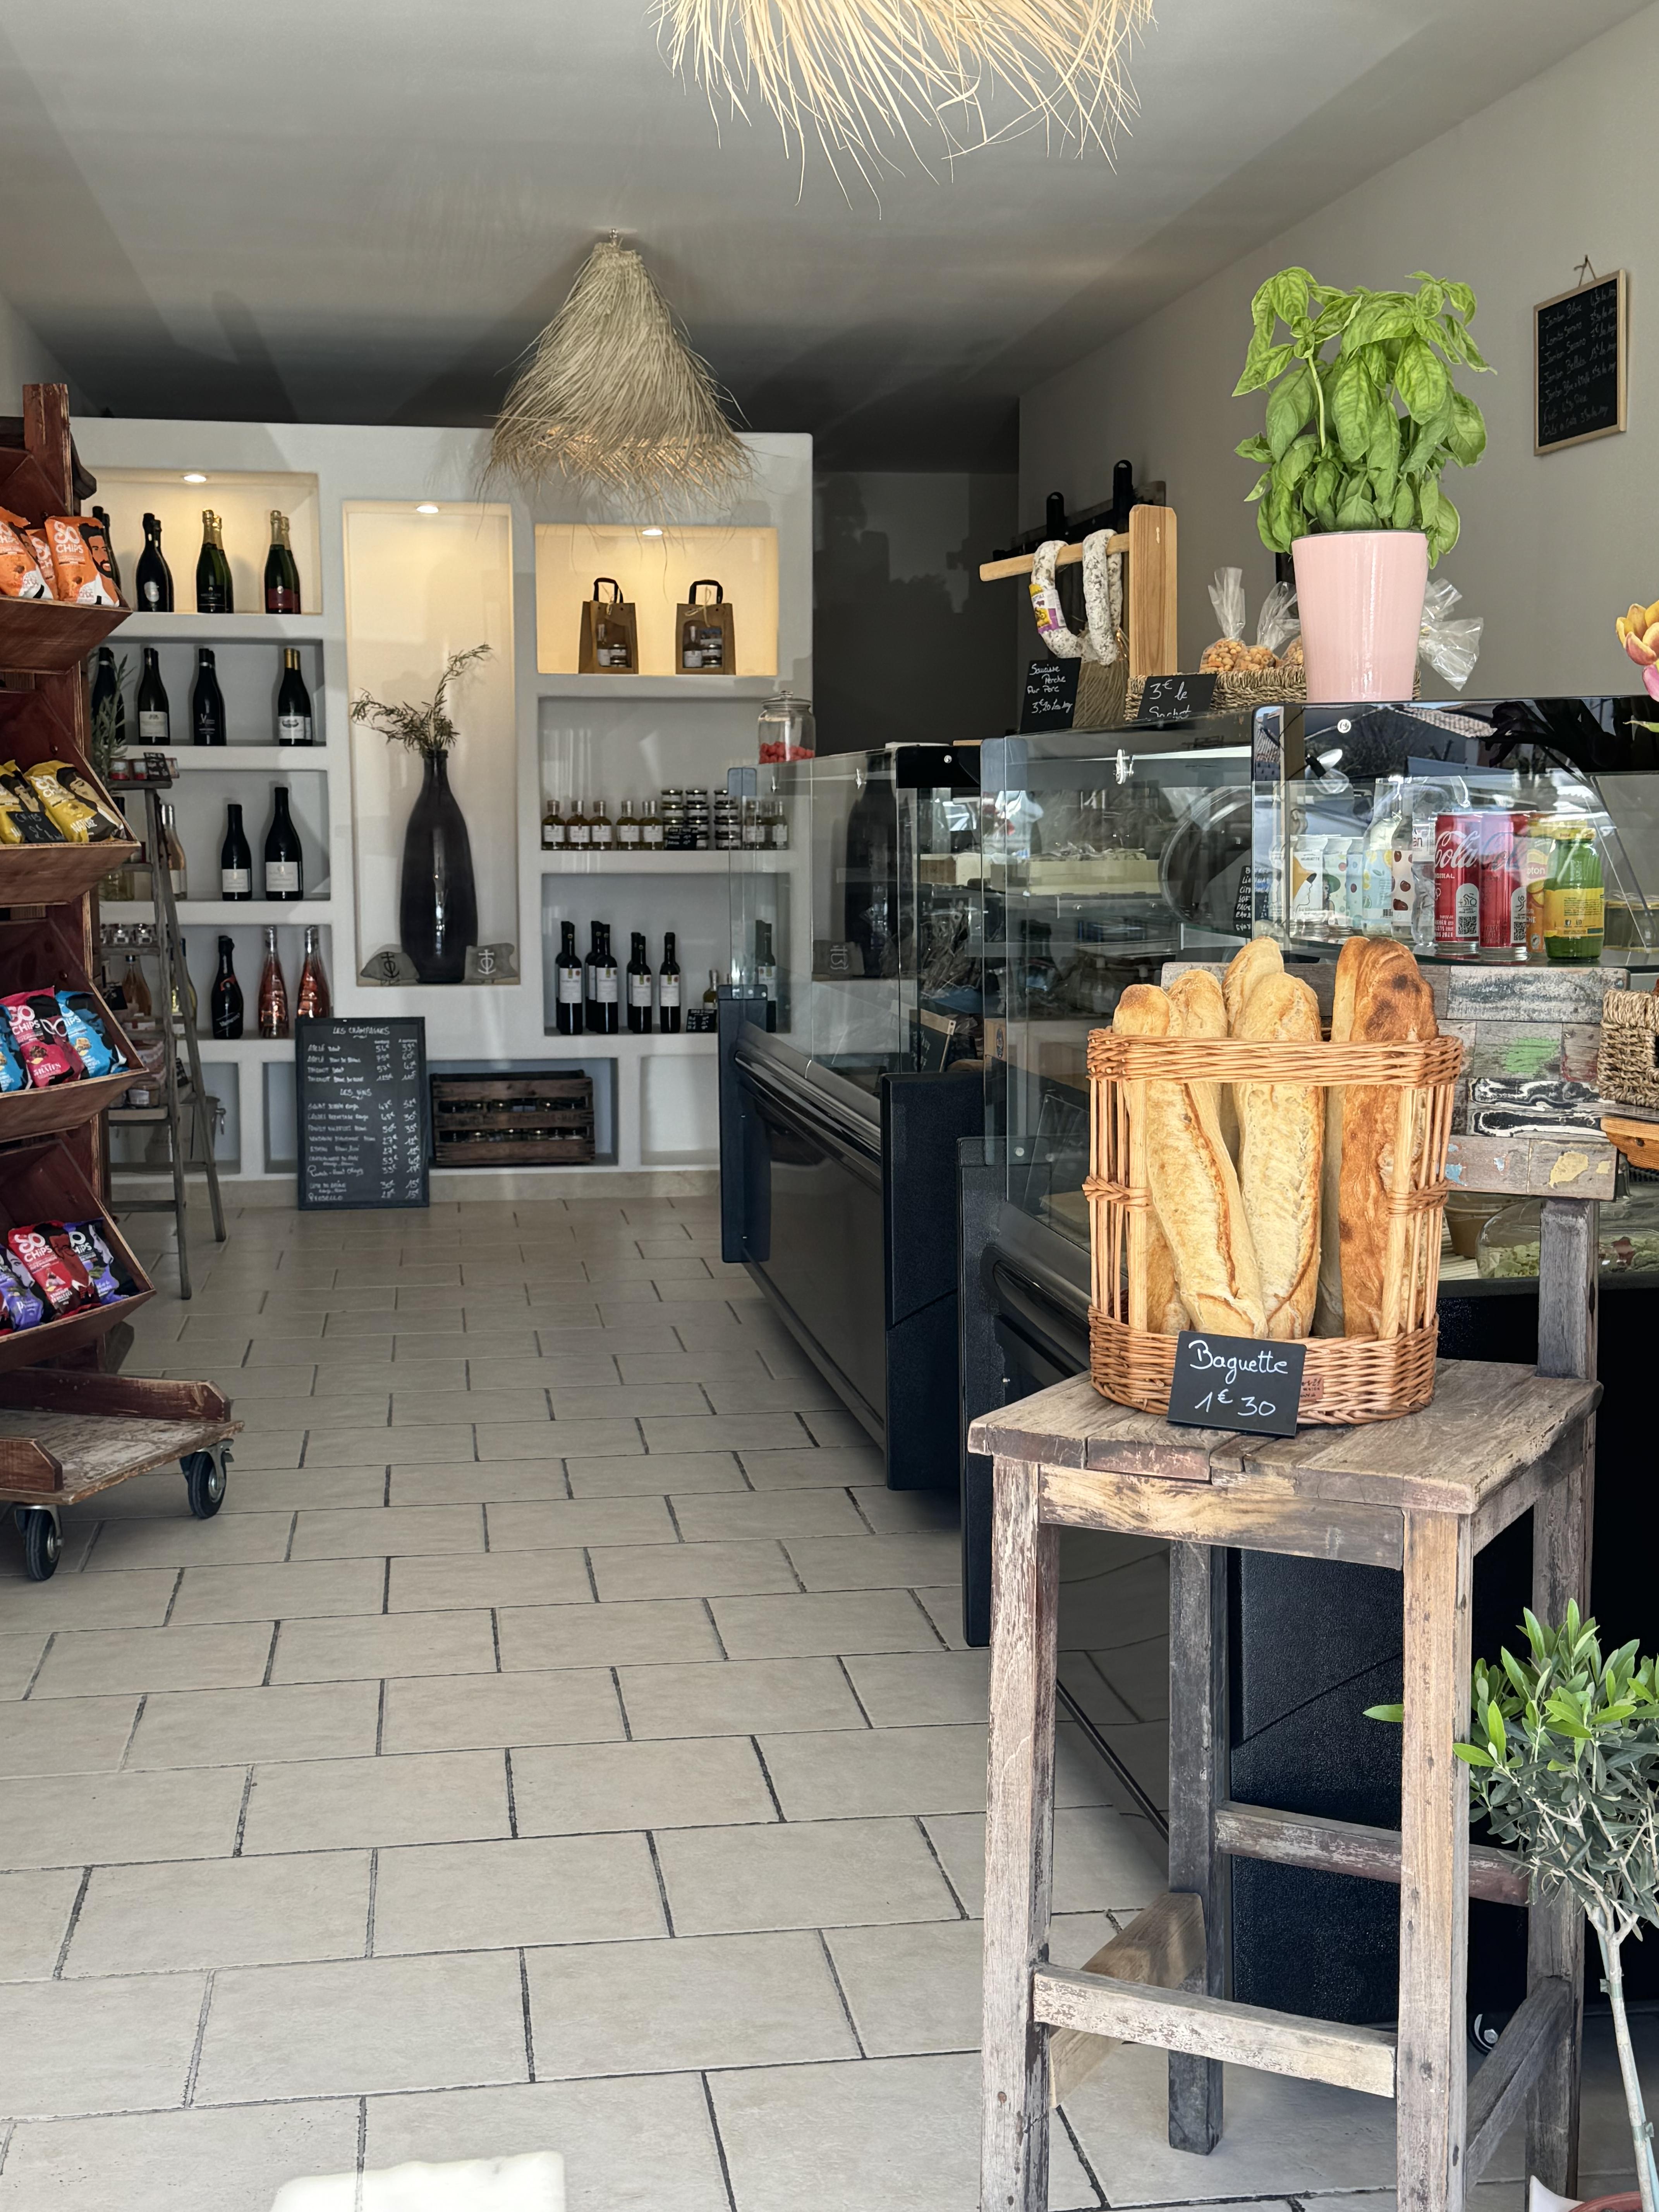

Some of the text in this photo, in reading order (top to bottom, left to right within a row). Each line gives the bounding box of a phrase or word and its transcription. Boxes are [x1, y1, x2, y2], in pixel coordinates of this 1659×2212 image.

[54, 521, 80, 544] SO
[1175, 682, 1187, 701] le
[348, 1026, 390, 1035] CHAMPAGNES
[14, 1233, 45, 1253] SO
[1188, 1340, 1288, 1384] Baguette
